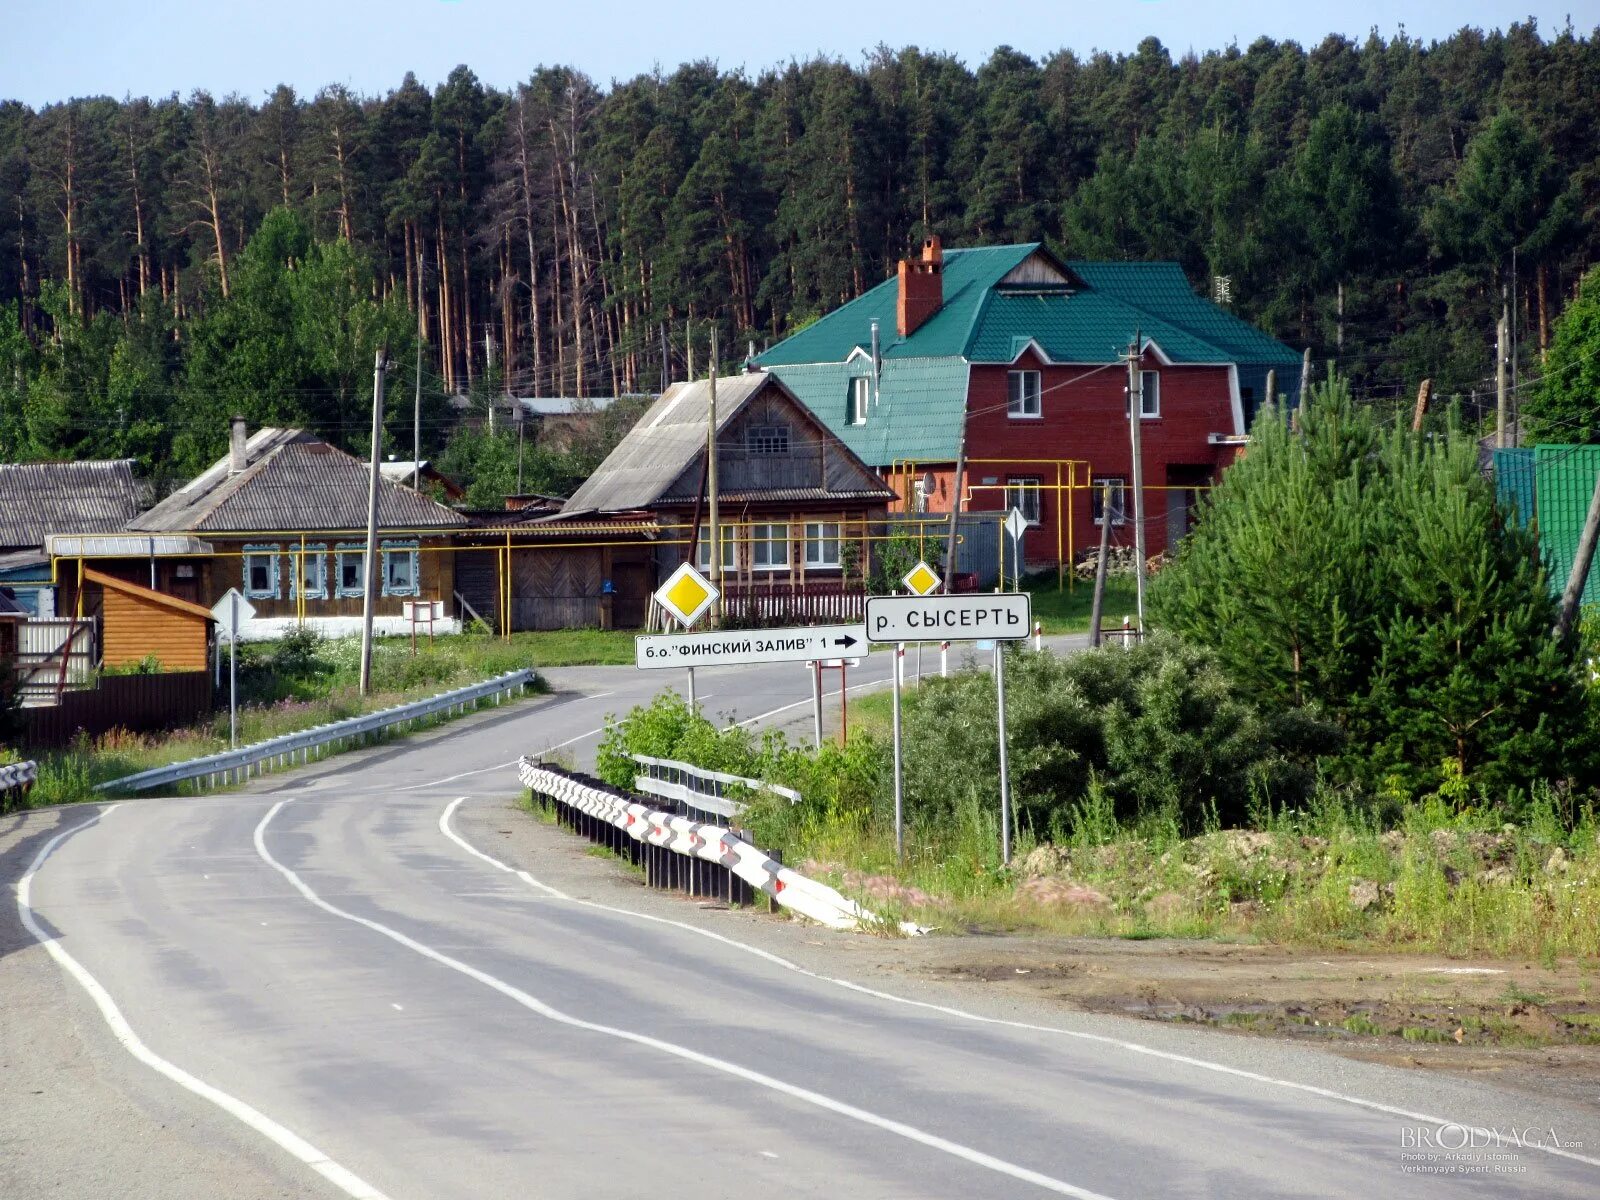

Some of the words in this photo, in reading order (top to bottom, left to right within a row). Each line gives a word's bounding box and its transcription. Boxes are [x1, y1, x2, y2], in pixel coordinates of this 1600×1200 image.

[876, 615, 895, 632] р.
[906, 608, 1019, 628] СЫСЕРТЬ
[820, 637, 827, 648] 1
